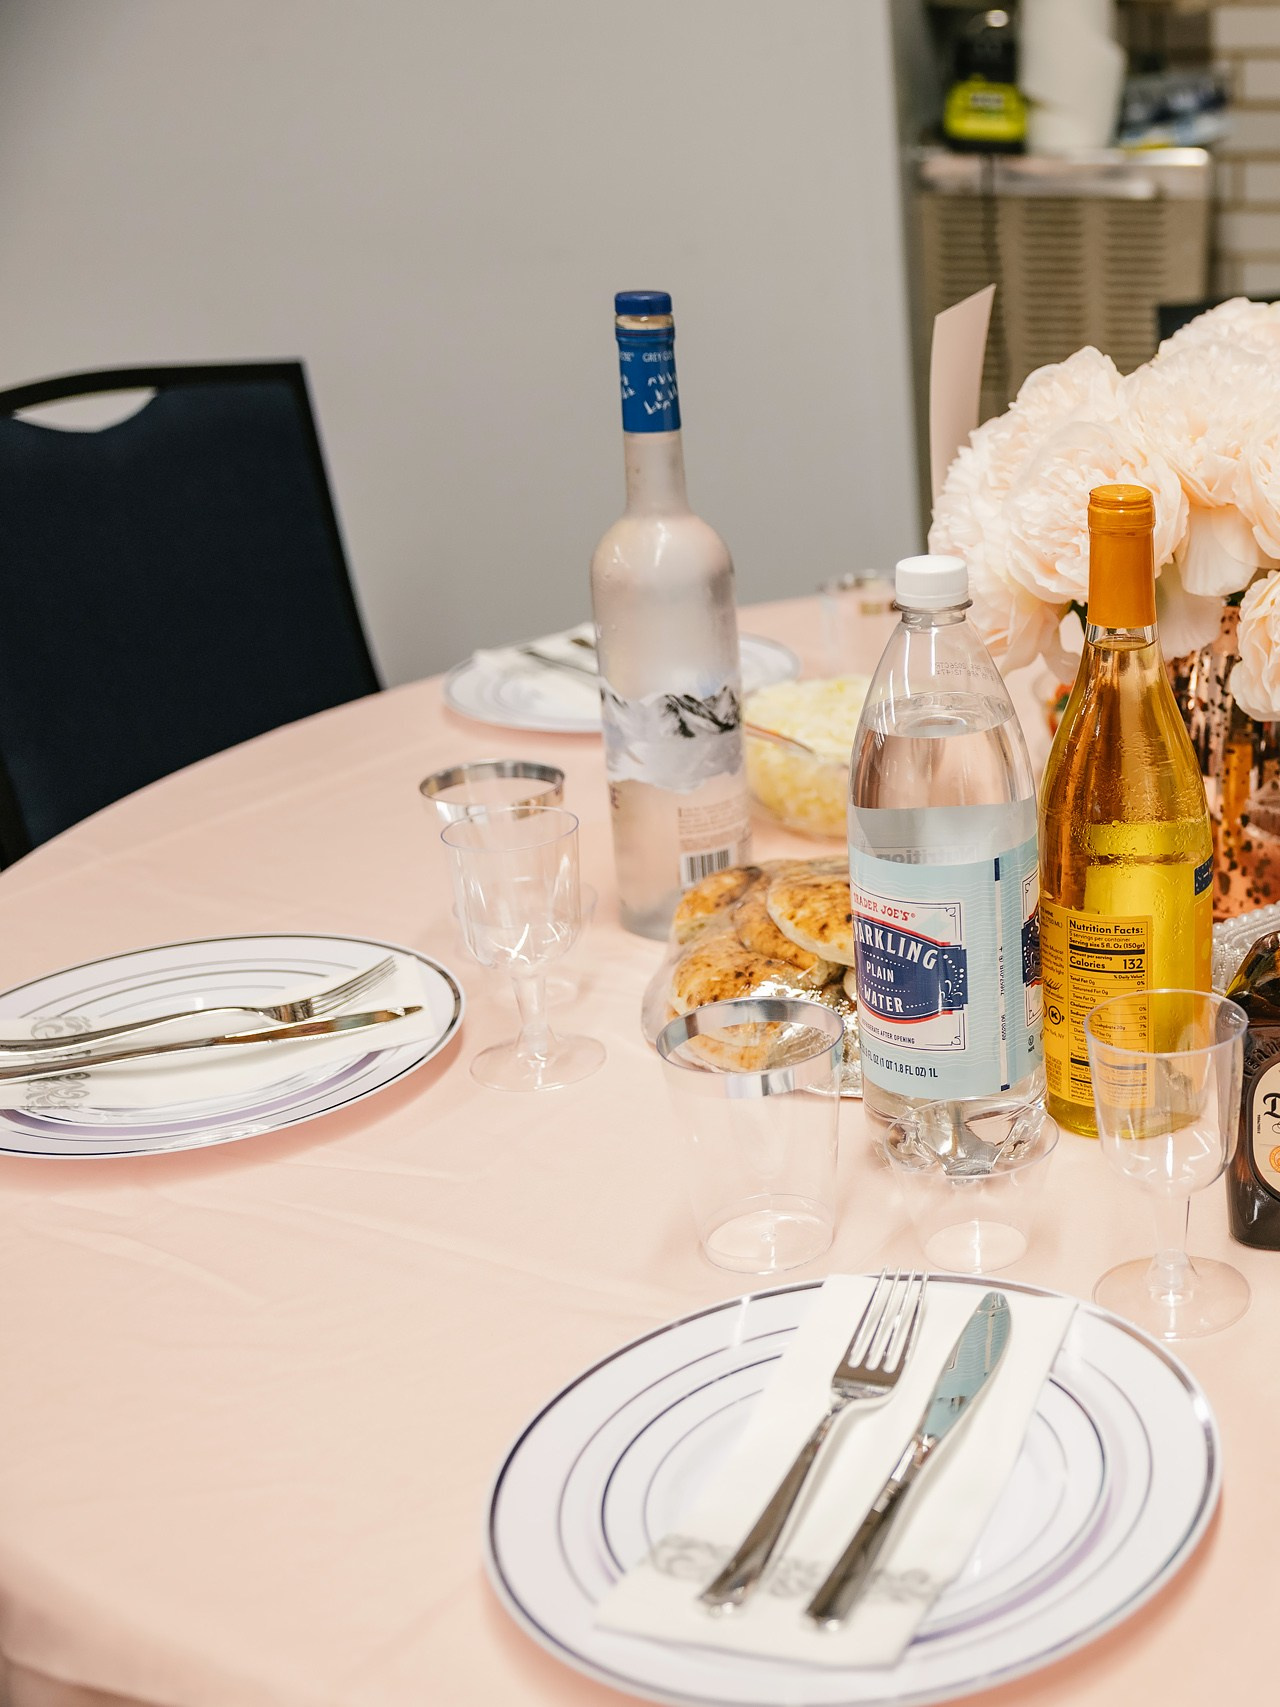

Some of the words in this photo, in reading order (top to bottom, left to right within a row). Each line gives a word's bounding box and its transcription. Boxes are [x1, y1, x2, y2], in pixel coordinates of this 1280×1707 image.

[1069, 919, 1112, 934] Nutrition
[1114, 925, 1143, 934] Facts:
[853, 920, 938, 970] PARKLING
[1069, 937, 1089, 947] Serving
[1123, 942, 1146, 950] (150gr)
[866, 960, 894, 983] PLAIN
[1069, 956, 1106, 969] Calories
[1122, 958, 1143, 970] 132
[864, 984, 904, 1013] WATER
[894, 1034, 915, 1045] OPENING
[885, 1059, 893, 1071] QT
[894, 1062, 904, 1074] 1.8
[905, 1064, 914, 1076] FL
[915, 1066, 926, 1078] OZ)
[928, 1067, 938, 1078] 1L
